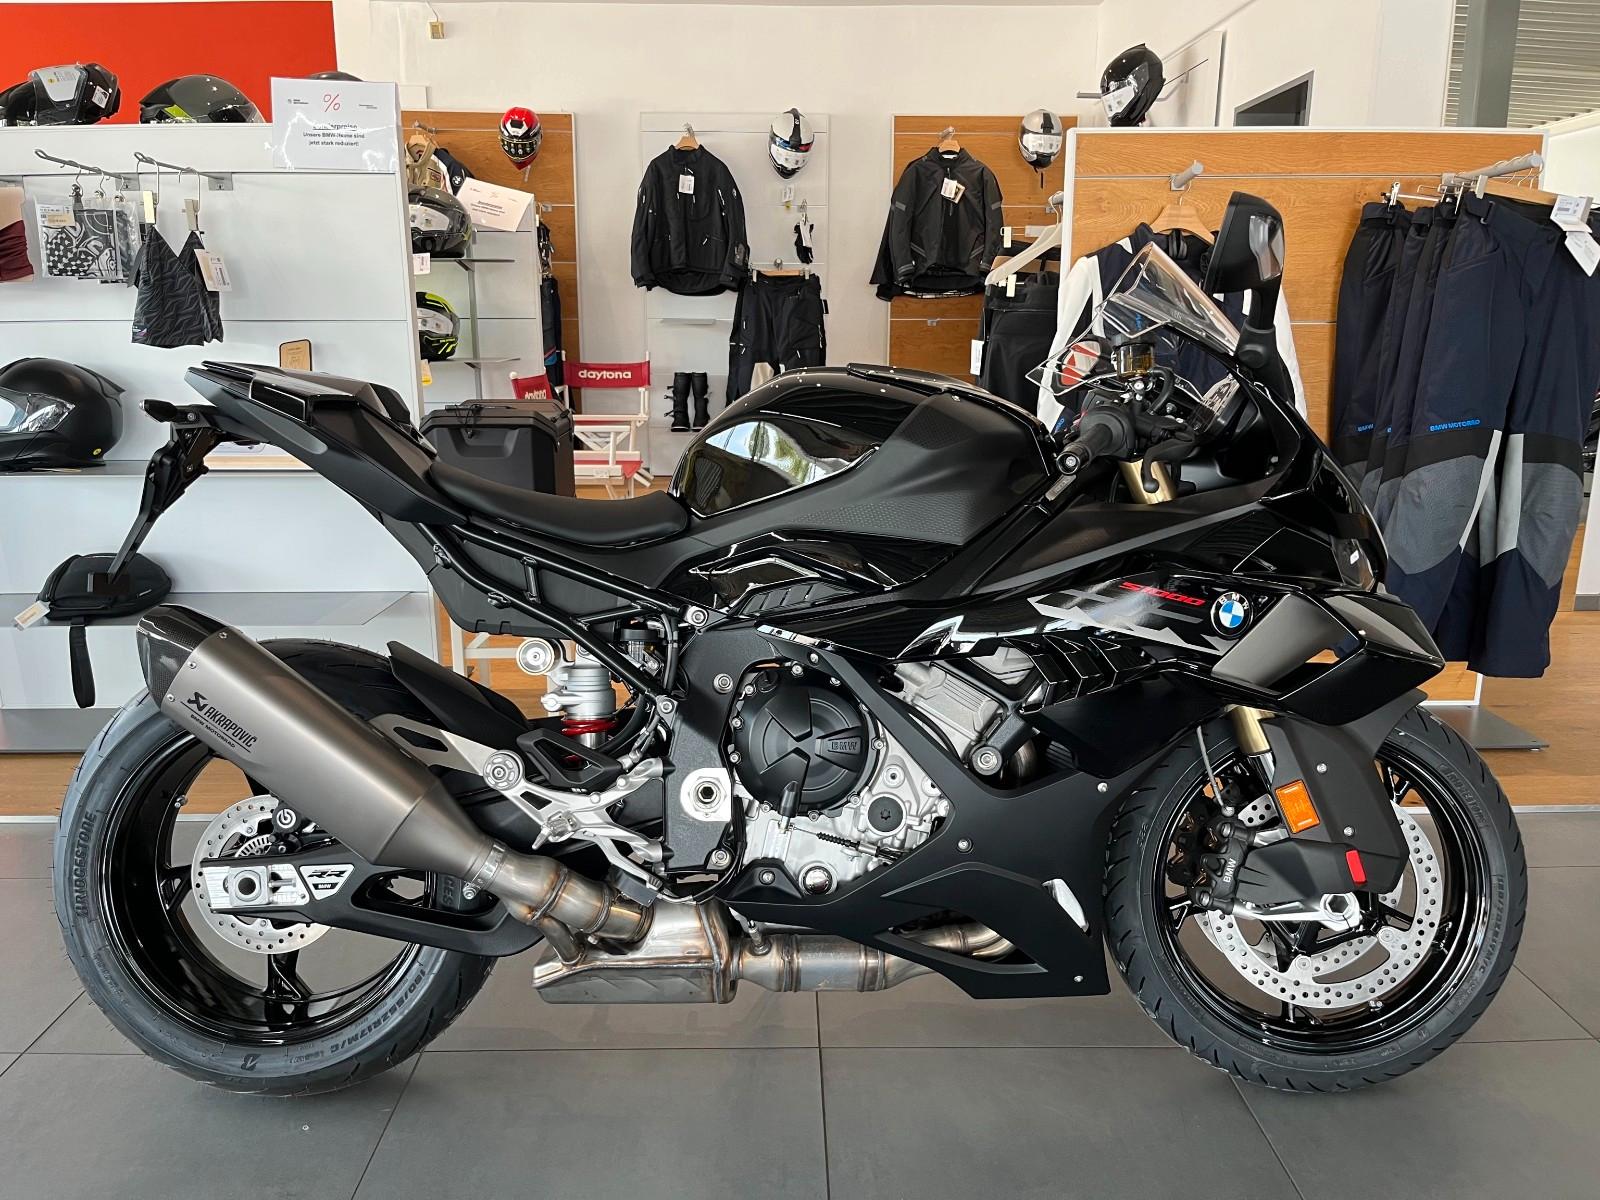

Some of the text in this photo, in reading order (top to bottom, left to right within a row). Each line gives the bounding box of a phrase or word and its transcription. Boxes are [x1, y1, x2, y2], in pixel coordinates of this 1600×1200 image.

[578, 369, 632, 380] daytona
[1430, 424, 1448, 432] BMW
[831, 741, 858, 751] BMW
[1223, 858, 1237, 883] BMW
